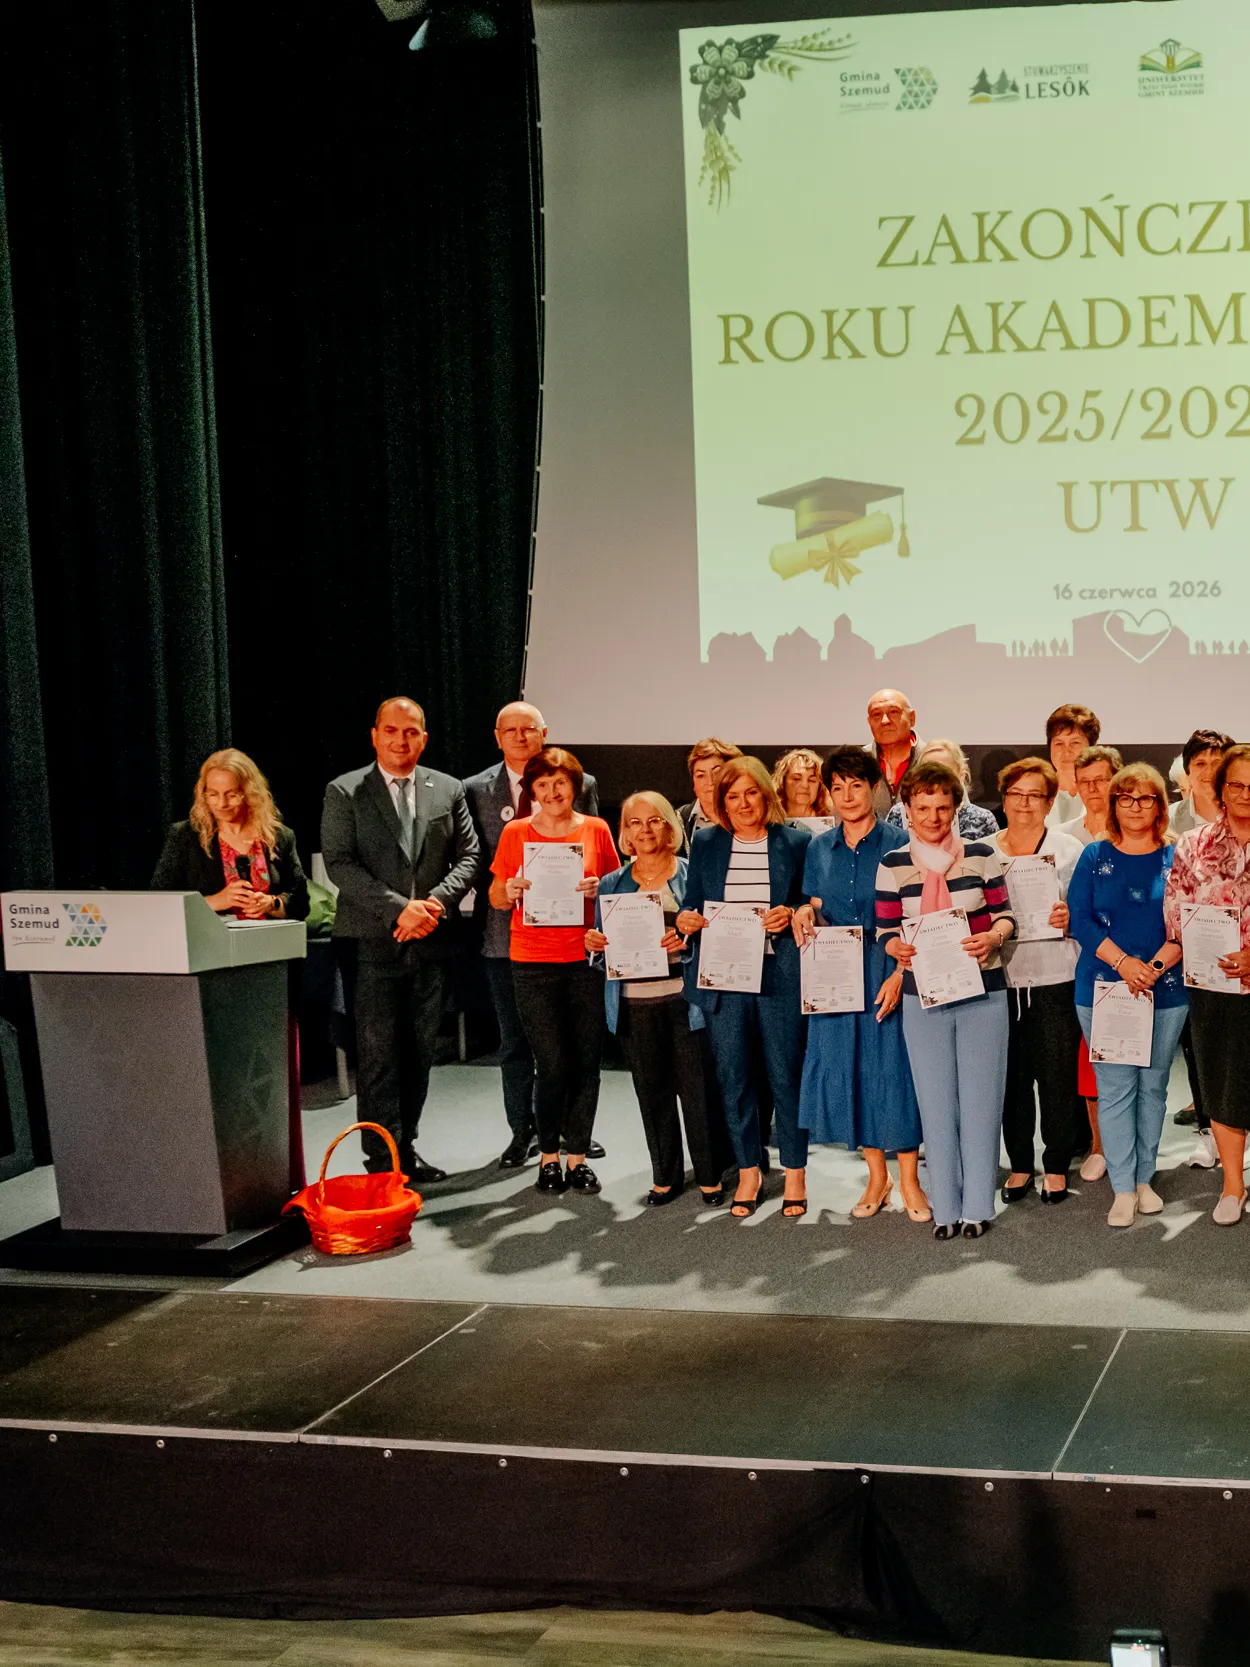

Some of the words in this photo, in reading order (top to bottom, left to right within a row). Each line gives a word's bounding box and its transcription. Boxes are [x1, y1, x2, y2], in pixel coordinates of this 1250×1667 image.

[840, 70, 881, 82] Gmina
[840, 83, 890, 97] Szemud
[1025, 76, 1090, 99] LESÔK
[717, 306, 915, 365] ROKU
[1057, 477, 1235, 533] UTW
[1053, 583, 1073, 600] 16
[1079, 587, 1157, 600] czerwca
[1169, 580, 1222, 598] 2026
[9, 904, 50, 915] Gmina
[10, 918, 60, 929] Szemud
